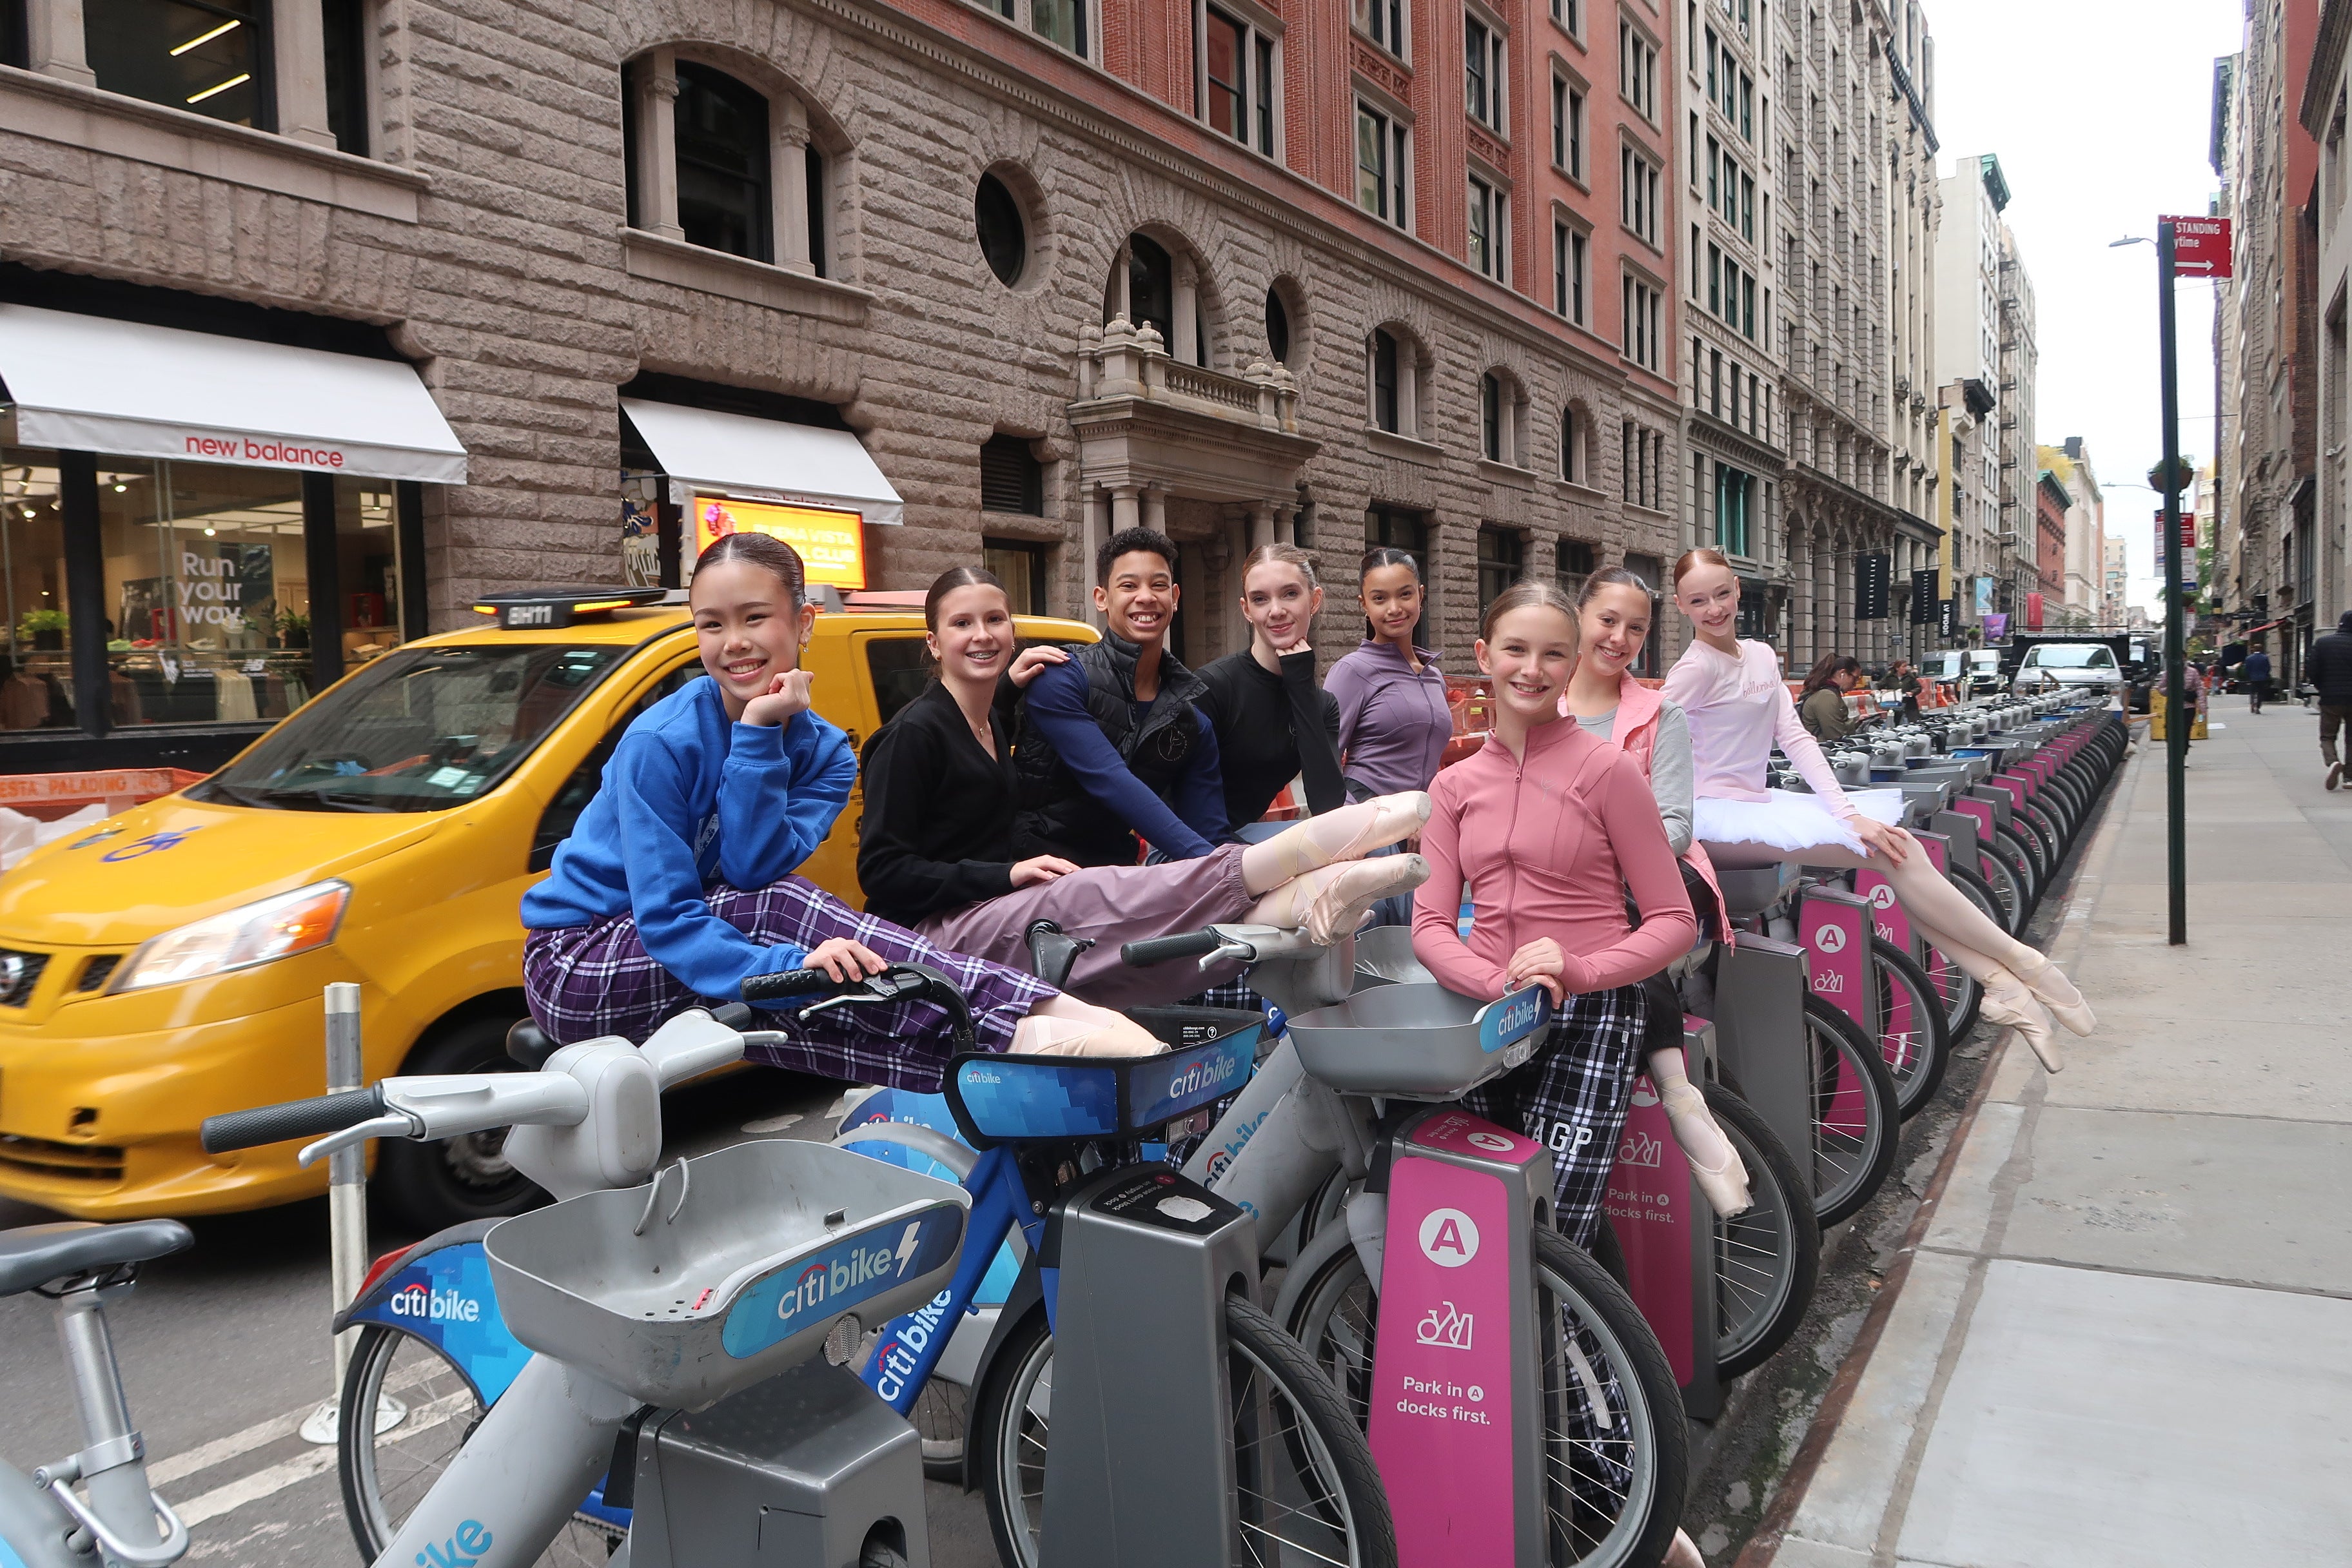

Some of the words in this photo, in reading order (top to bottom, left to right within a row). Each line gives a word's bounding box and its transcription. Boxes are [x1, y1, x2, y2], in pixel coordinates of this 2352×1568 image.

[2176, 222, 2220, 234] STANDING
[2173, 236, 2200, 250] ytime
[186, 437, 237, 456] new
[244, 438, 343, 467] balance
[808, 528, 855, 545] VISTA
[811, 546, 856, 563] CLUB
[182, 552, 235, 576] Run
[177, 582, 242, 605] your
[1609, 1188, 1637, 1202] Park
[1642, 1192, 1653, 1203] in
[1645, 1210, 1674, 1224] first.
[1404, 1376, 1442, 1395] Park
[1447, 1382, 1462, 1397] in
[1396, 1399, 1447, 1418] docks
[1453, 1406, 1491, 1425] first.
